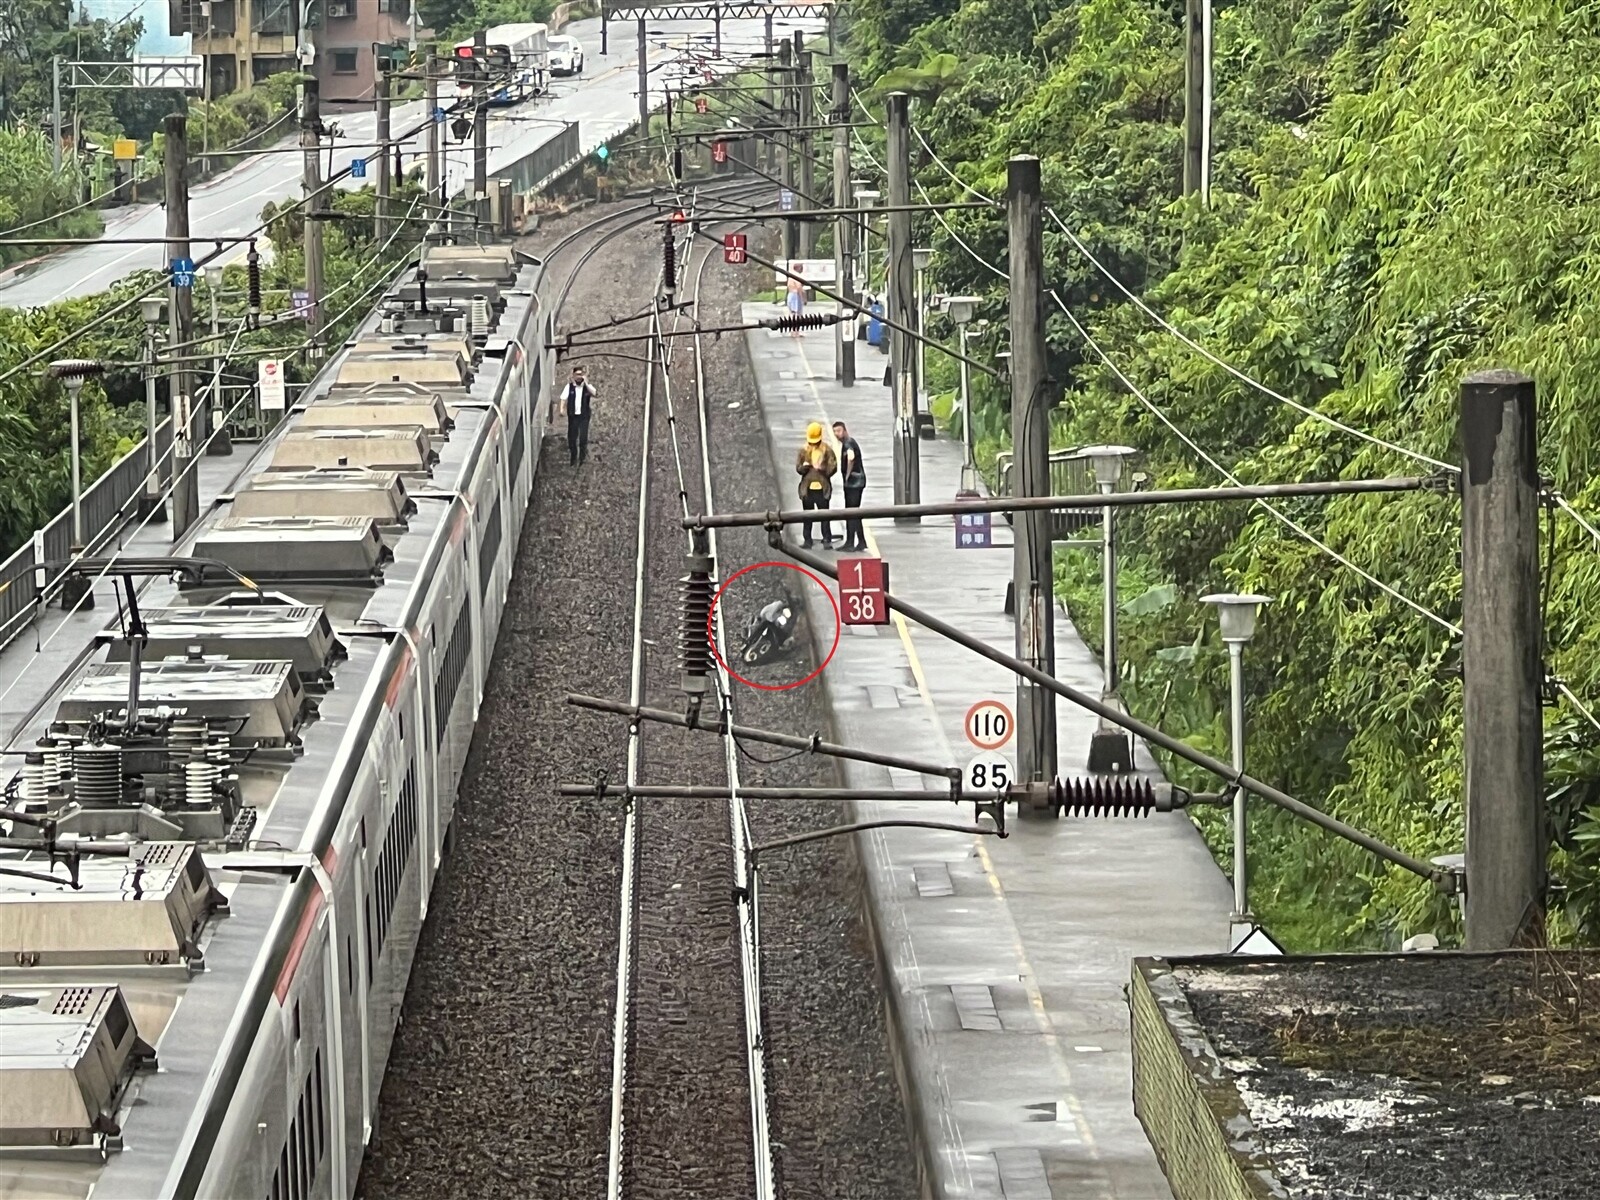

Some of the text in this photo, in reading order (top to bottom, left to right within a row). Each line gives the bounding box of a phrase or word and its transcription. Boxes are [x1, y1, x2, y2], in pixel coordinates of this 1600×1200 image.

[728, 250, 740, 262] 40
[177, 274, 190, 287] 39
[853, 561, 863, 587] 1
[849, 594, 875, 621] 38
[974, 713, 1006, 737] 110
[971, 763, 1008, 789] 85
